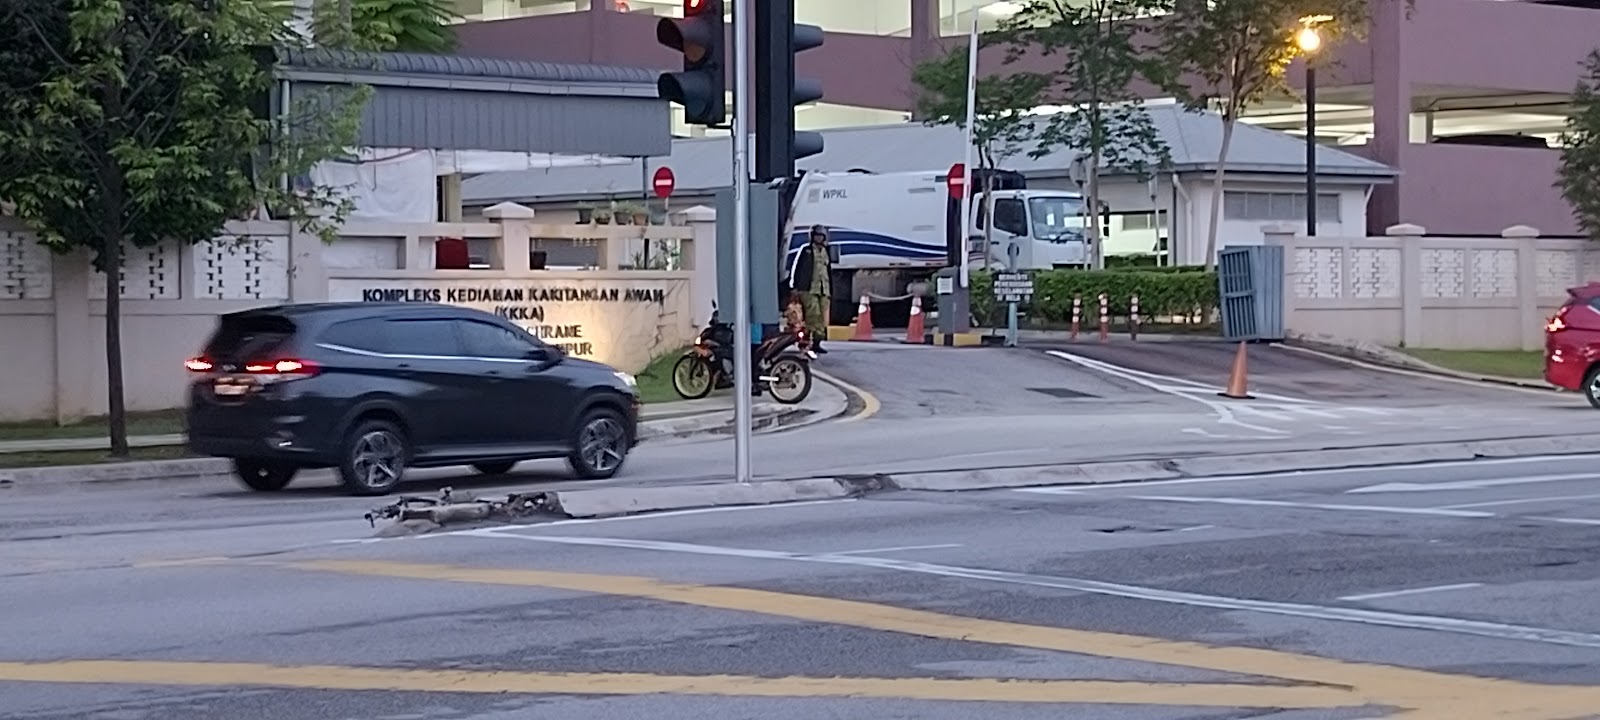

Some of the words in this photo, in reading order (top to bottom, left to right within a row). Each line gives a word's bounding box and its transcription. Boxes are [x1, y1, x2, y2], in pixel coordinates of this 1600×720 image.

[823, 189, 848, 199] WPKL
[363, 289, 441, 302] KOMPLEKS
[447, 289, 523, 302] KEDIAMAN
[528, 289, 619, 302] KAKITANGAN
[624, 289, 664, 302] AWAM
[495, 305, 545, 322] (KKKA)
[526, 324, 582, 338] CHRANE
